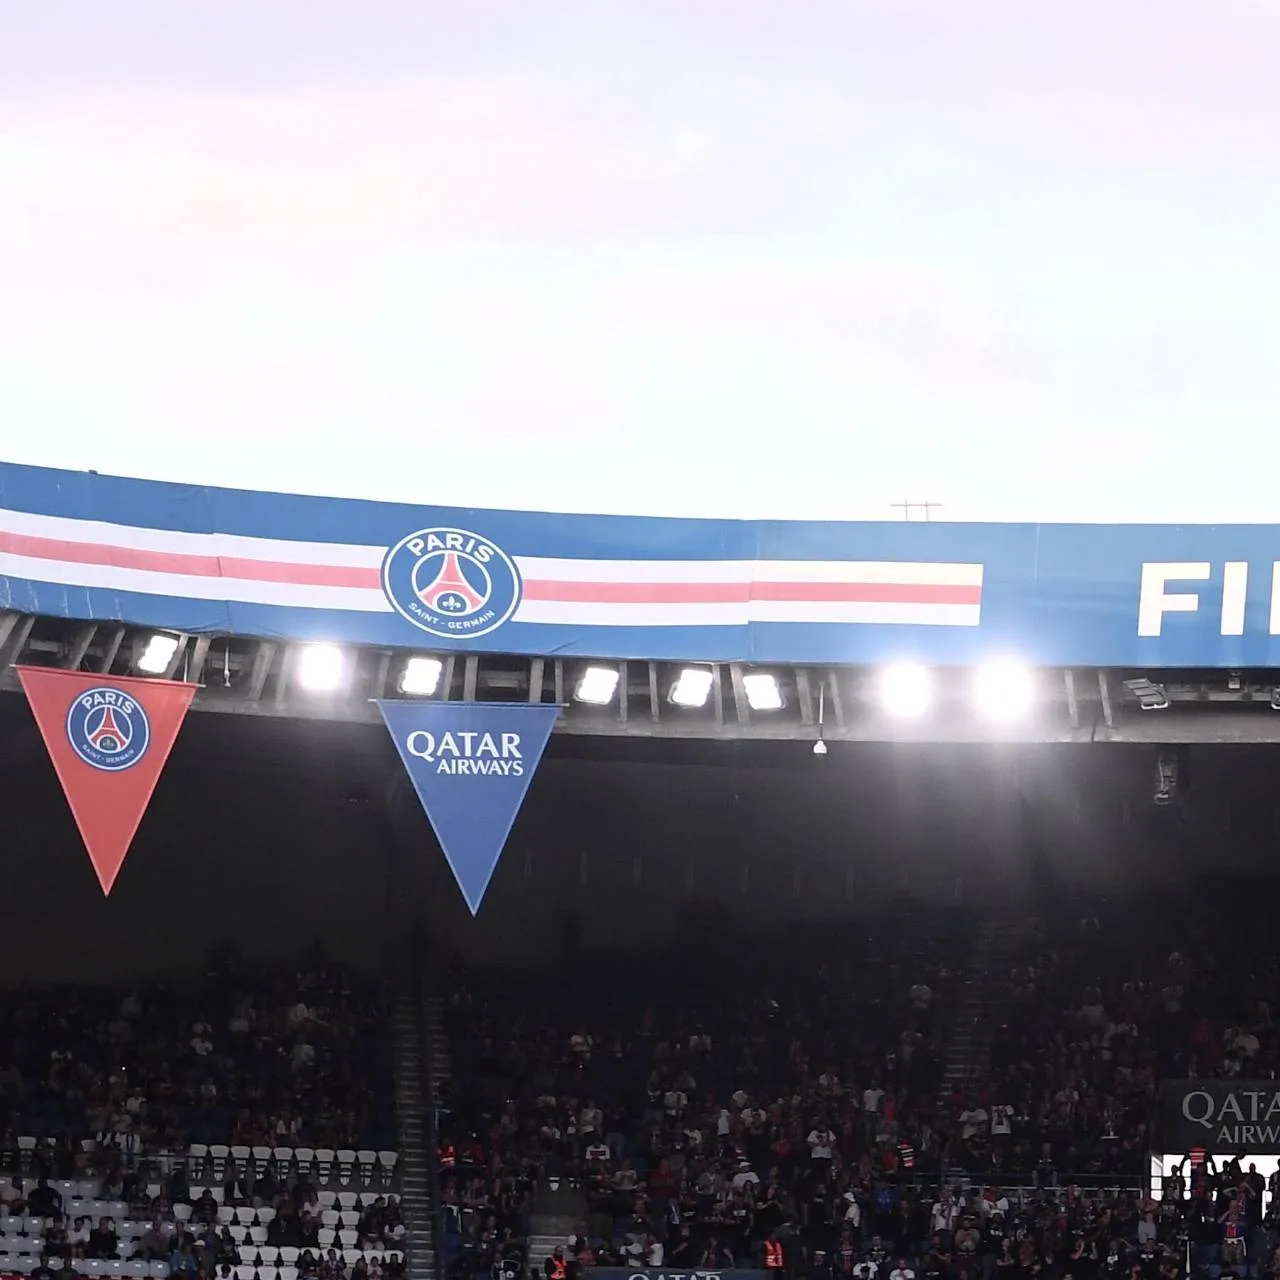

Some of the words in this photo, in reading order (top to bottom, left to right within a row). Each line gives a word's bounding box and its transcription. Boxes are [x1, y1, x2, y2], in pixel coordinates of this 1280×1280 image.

[406, 533, 495, 563] PARIS
[81, 692, 135, 714] PARIS
[407, 730, 523, 762] QATAR
[436, 758, 524, 776] AIRWAYS
